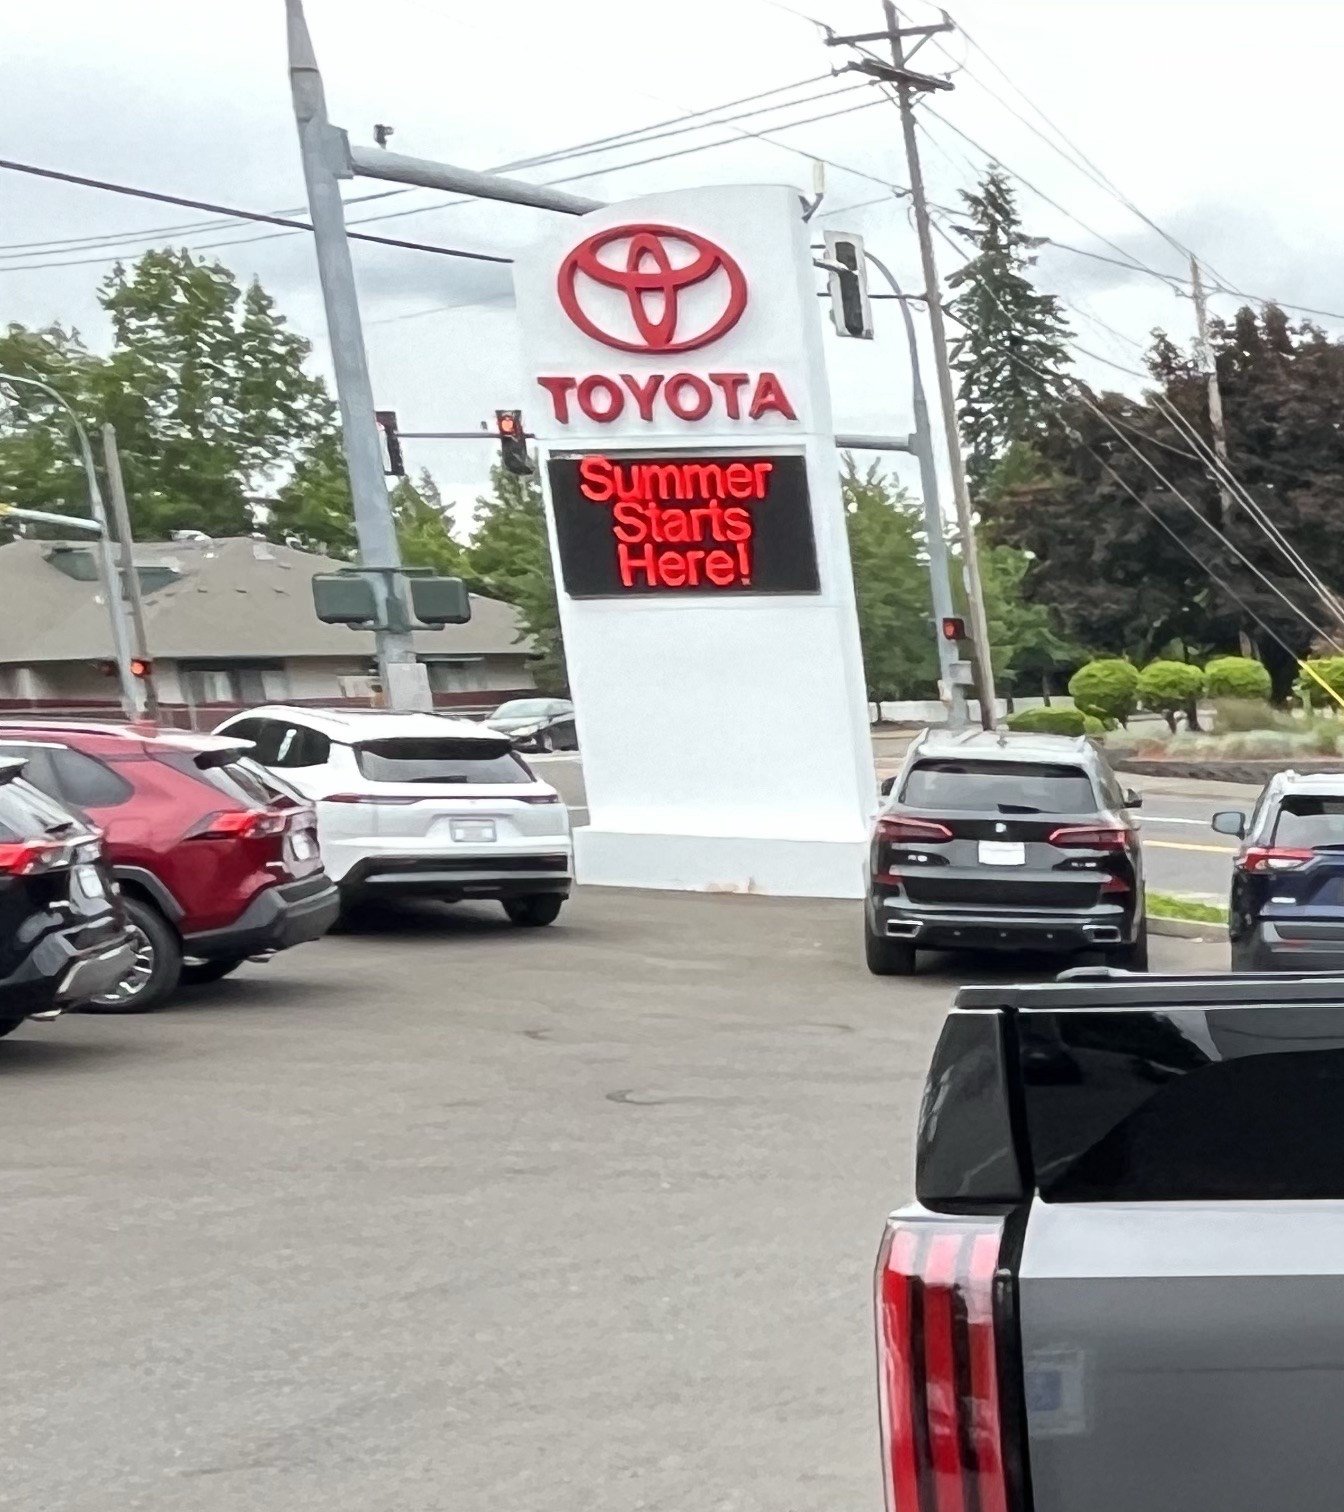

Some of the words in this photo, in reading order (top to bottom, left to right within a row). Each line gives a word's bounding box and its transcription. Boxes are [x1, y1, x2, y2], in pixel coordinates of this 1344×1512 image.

[537, 371, 799, 425] TOYOTA
[579, 453, 773, 501] Summer
[612, 499, 752, 543] Starts
[617, 543, 751, 587] Here!
